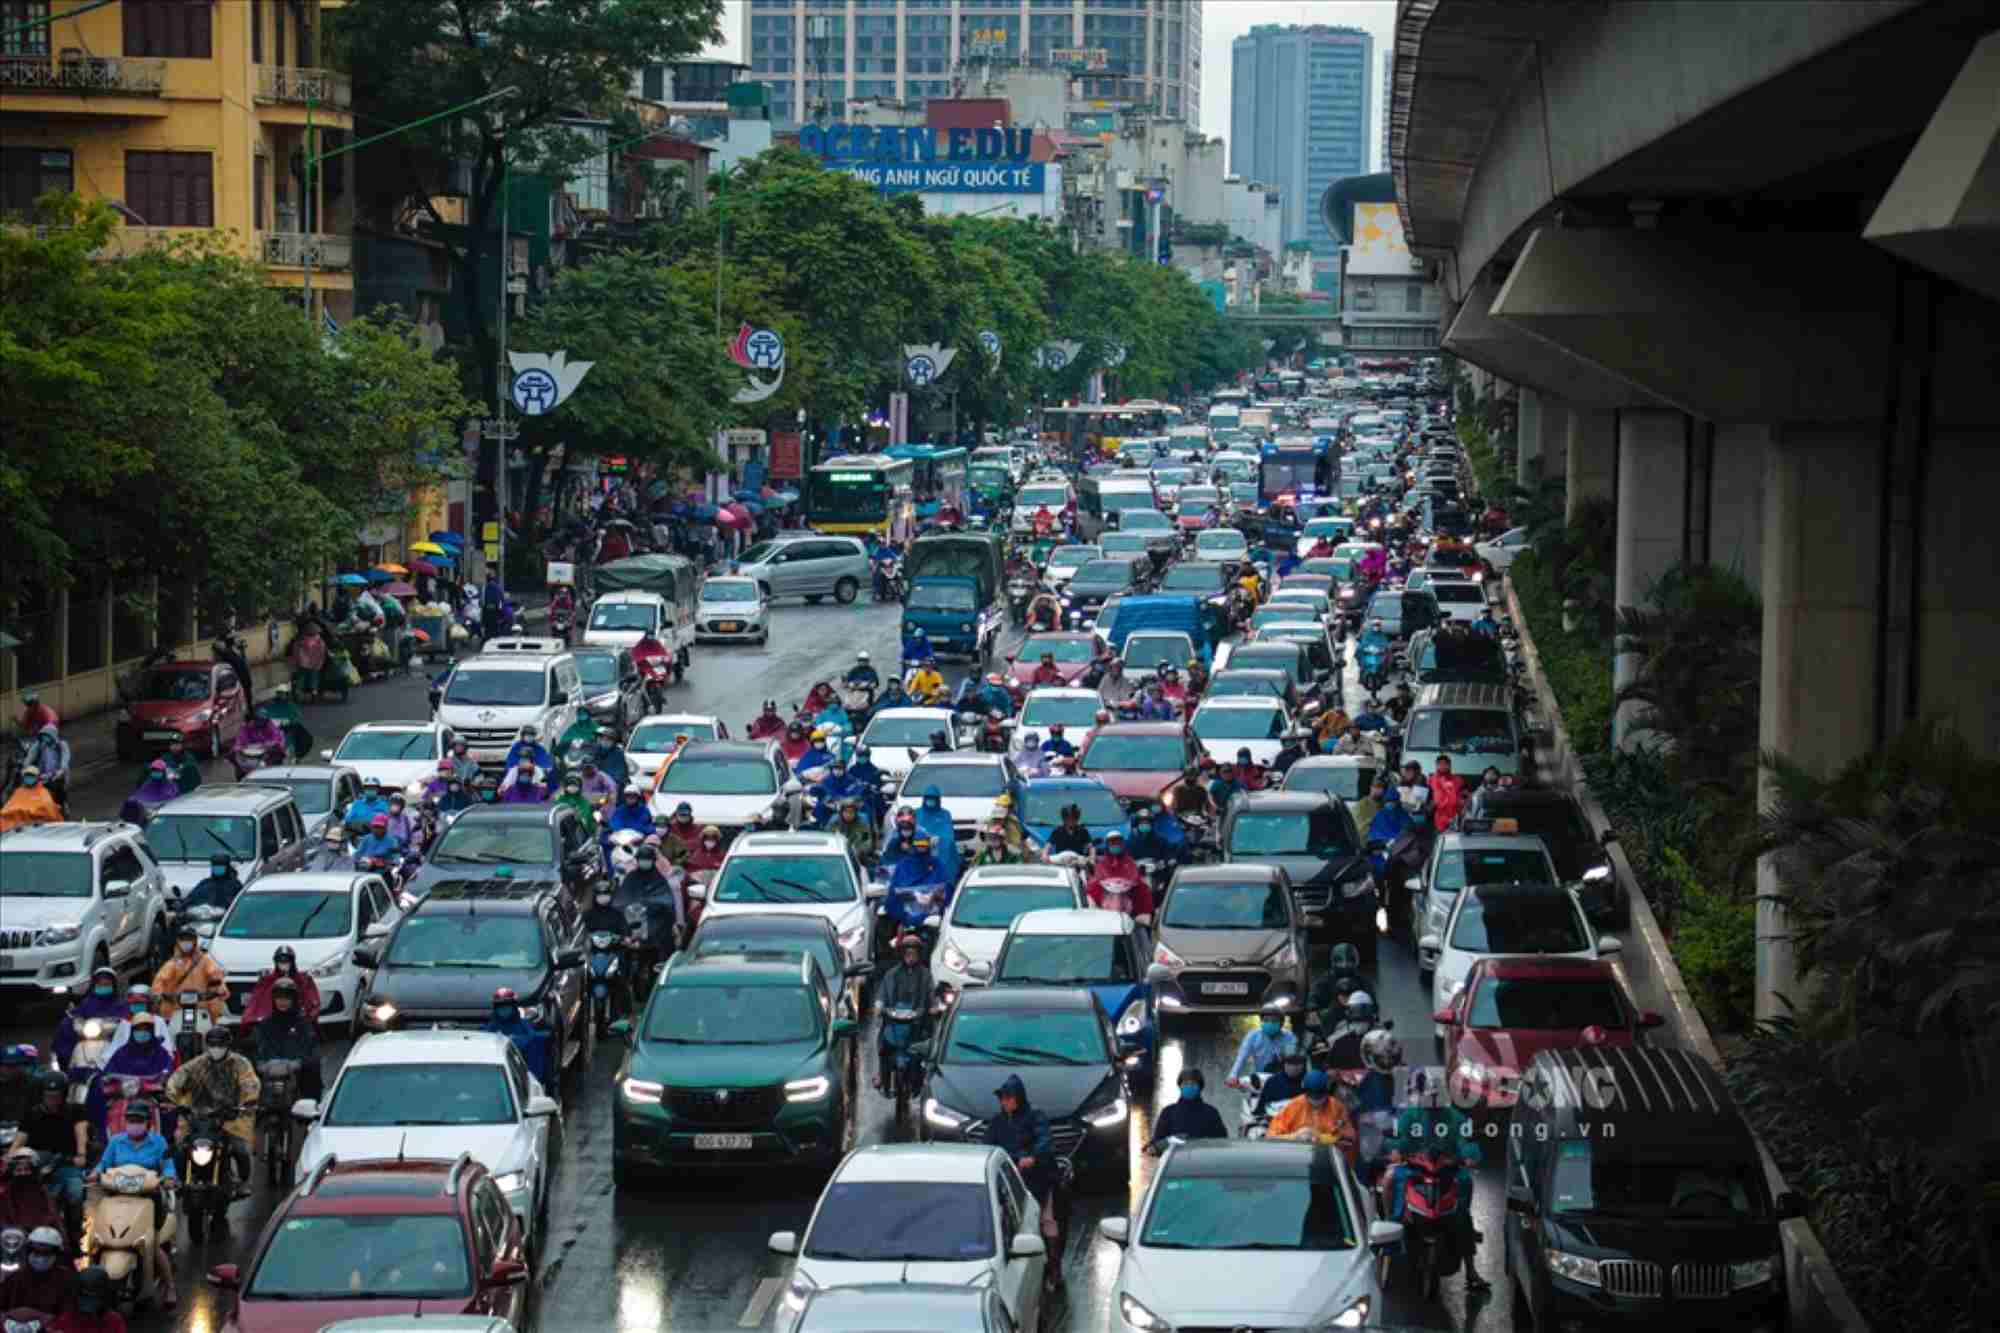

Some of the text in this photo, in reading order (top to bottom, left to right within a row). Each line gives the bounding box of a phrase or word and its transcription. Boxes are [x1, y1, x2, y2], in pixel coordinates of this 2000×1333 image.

[800, 123, 1033, 162] OCEAN EDU
[885, 168, 920, 185] ANH
[925, 165, 961, 185] NGỮ
[963, 162, 1008, 188] QUỐC
[1012, 163, 1033, 187] TẾ
